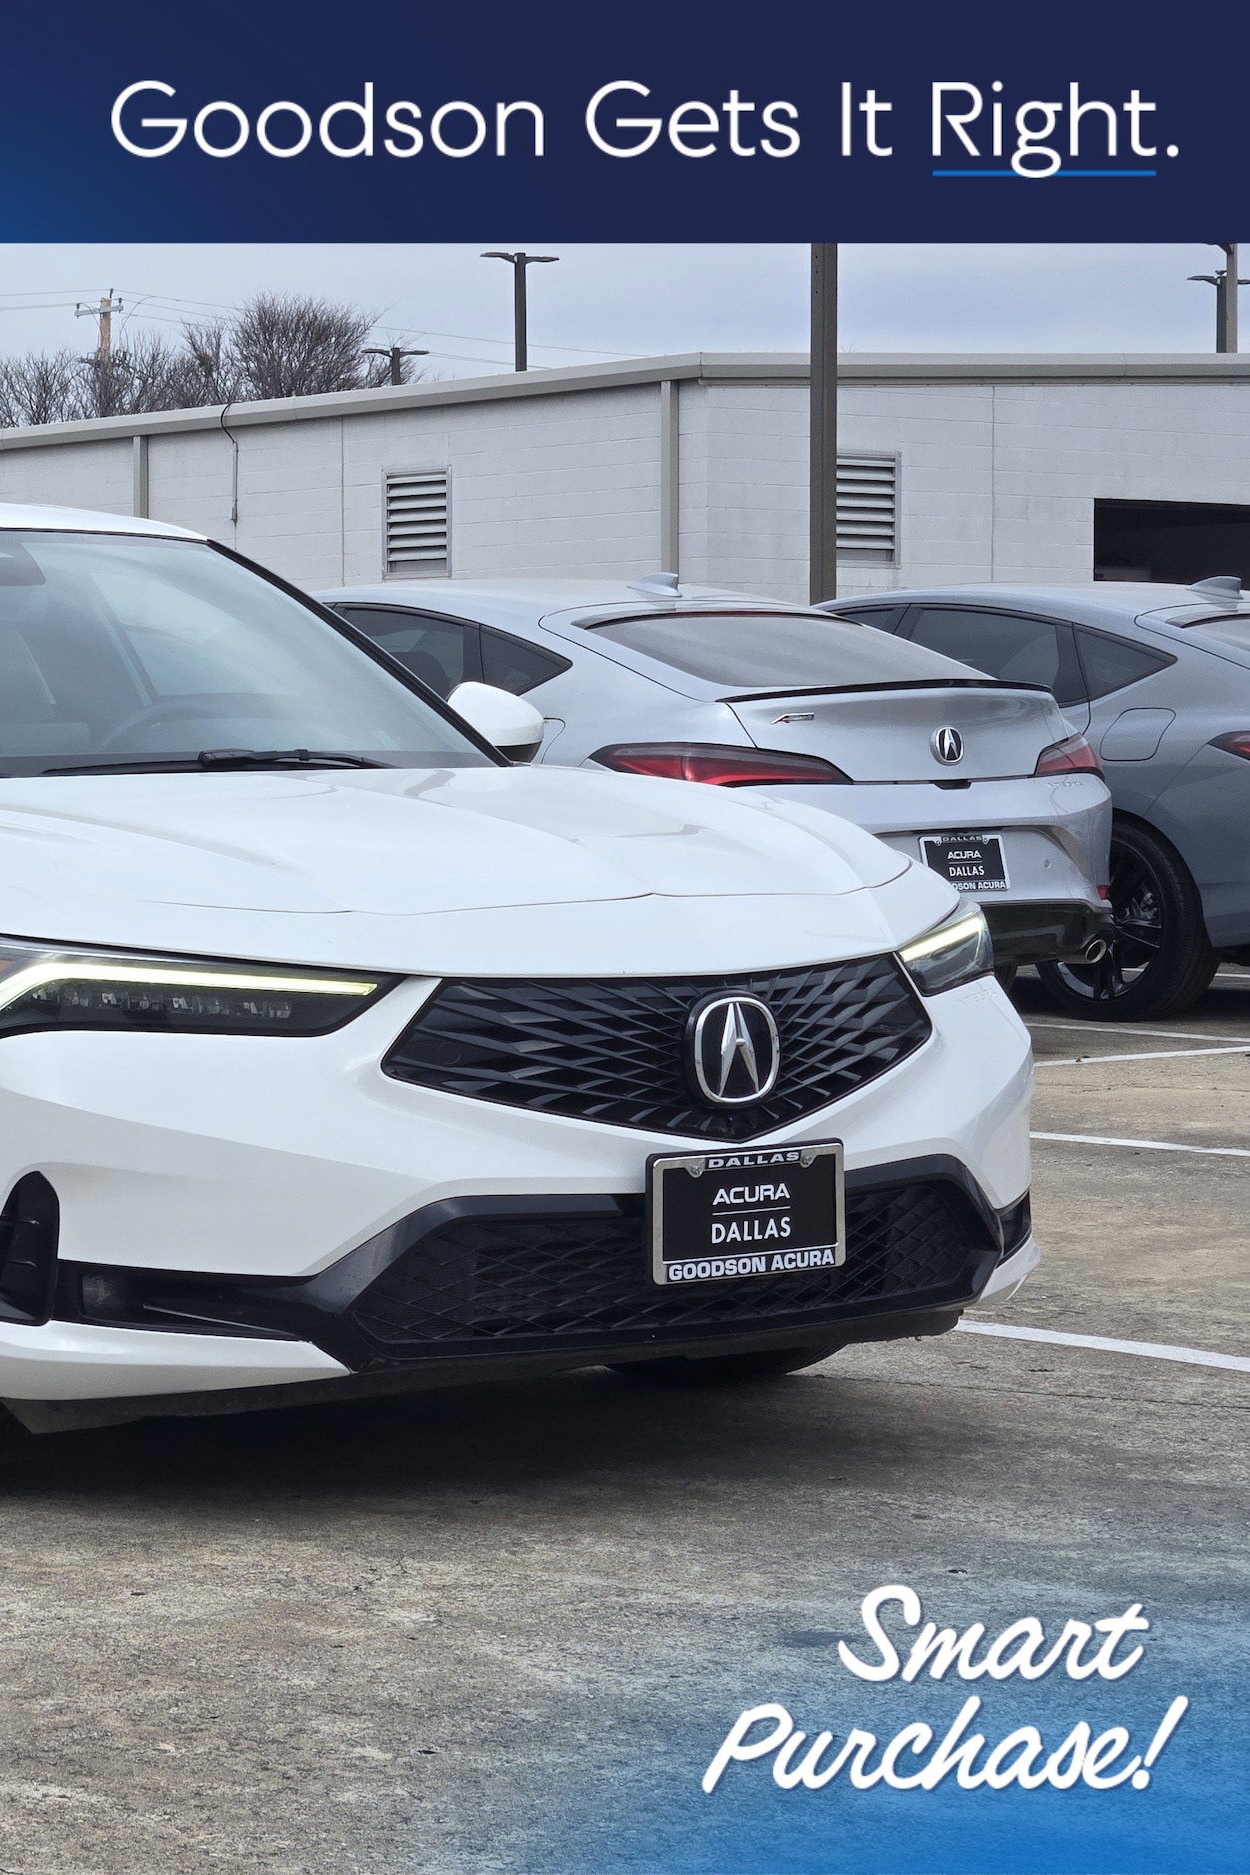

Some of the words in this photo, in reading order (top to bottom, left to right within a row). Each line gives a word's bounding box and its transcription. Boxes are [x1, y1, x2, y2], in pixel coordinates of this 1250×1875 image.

[948, 850, 982, 859] ACURA
[949, 866, 985, 877] DALLAS
[978, 881, 1006, 889] ACURA
[708, 1151, 800, 1168] DALLAS
[712, 1182, 791, 1206] ACURA
[711, 1216, 791, 1244] DALLAS
[668, 1256, 766, 1281] GOODSON
[771, 1249, 835, 1271] ACURA
